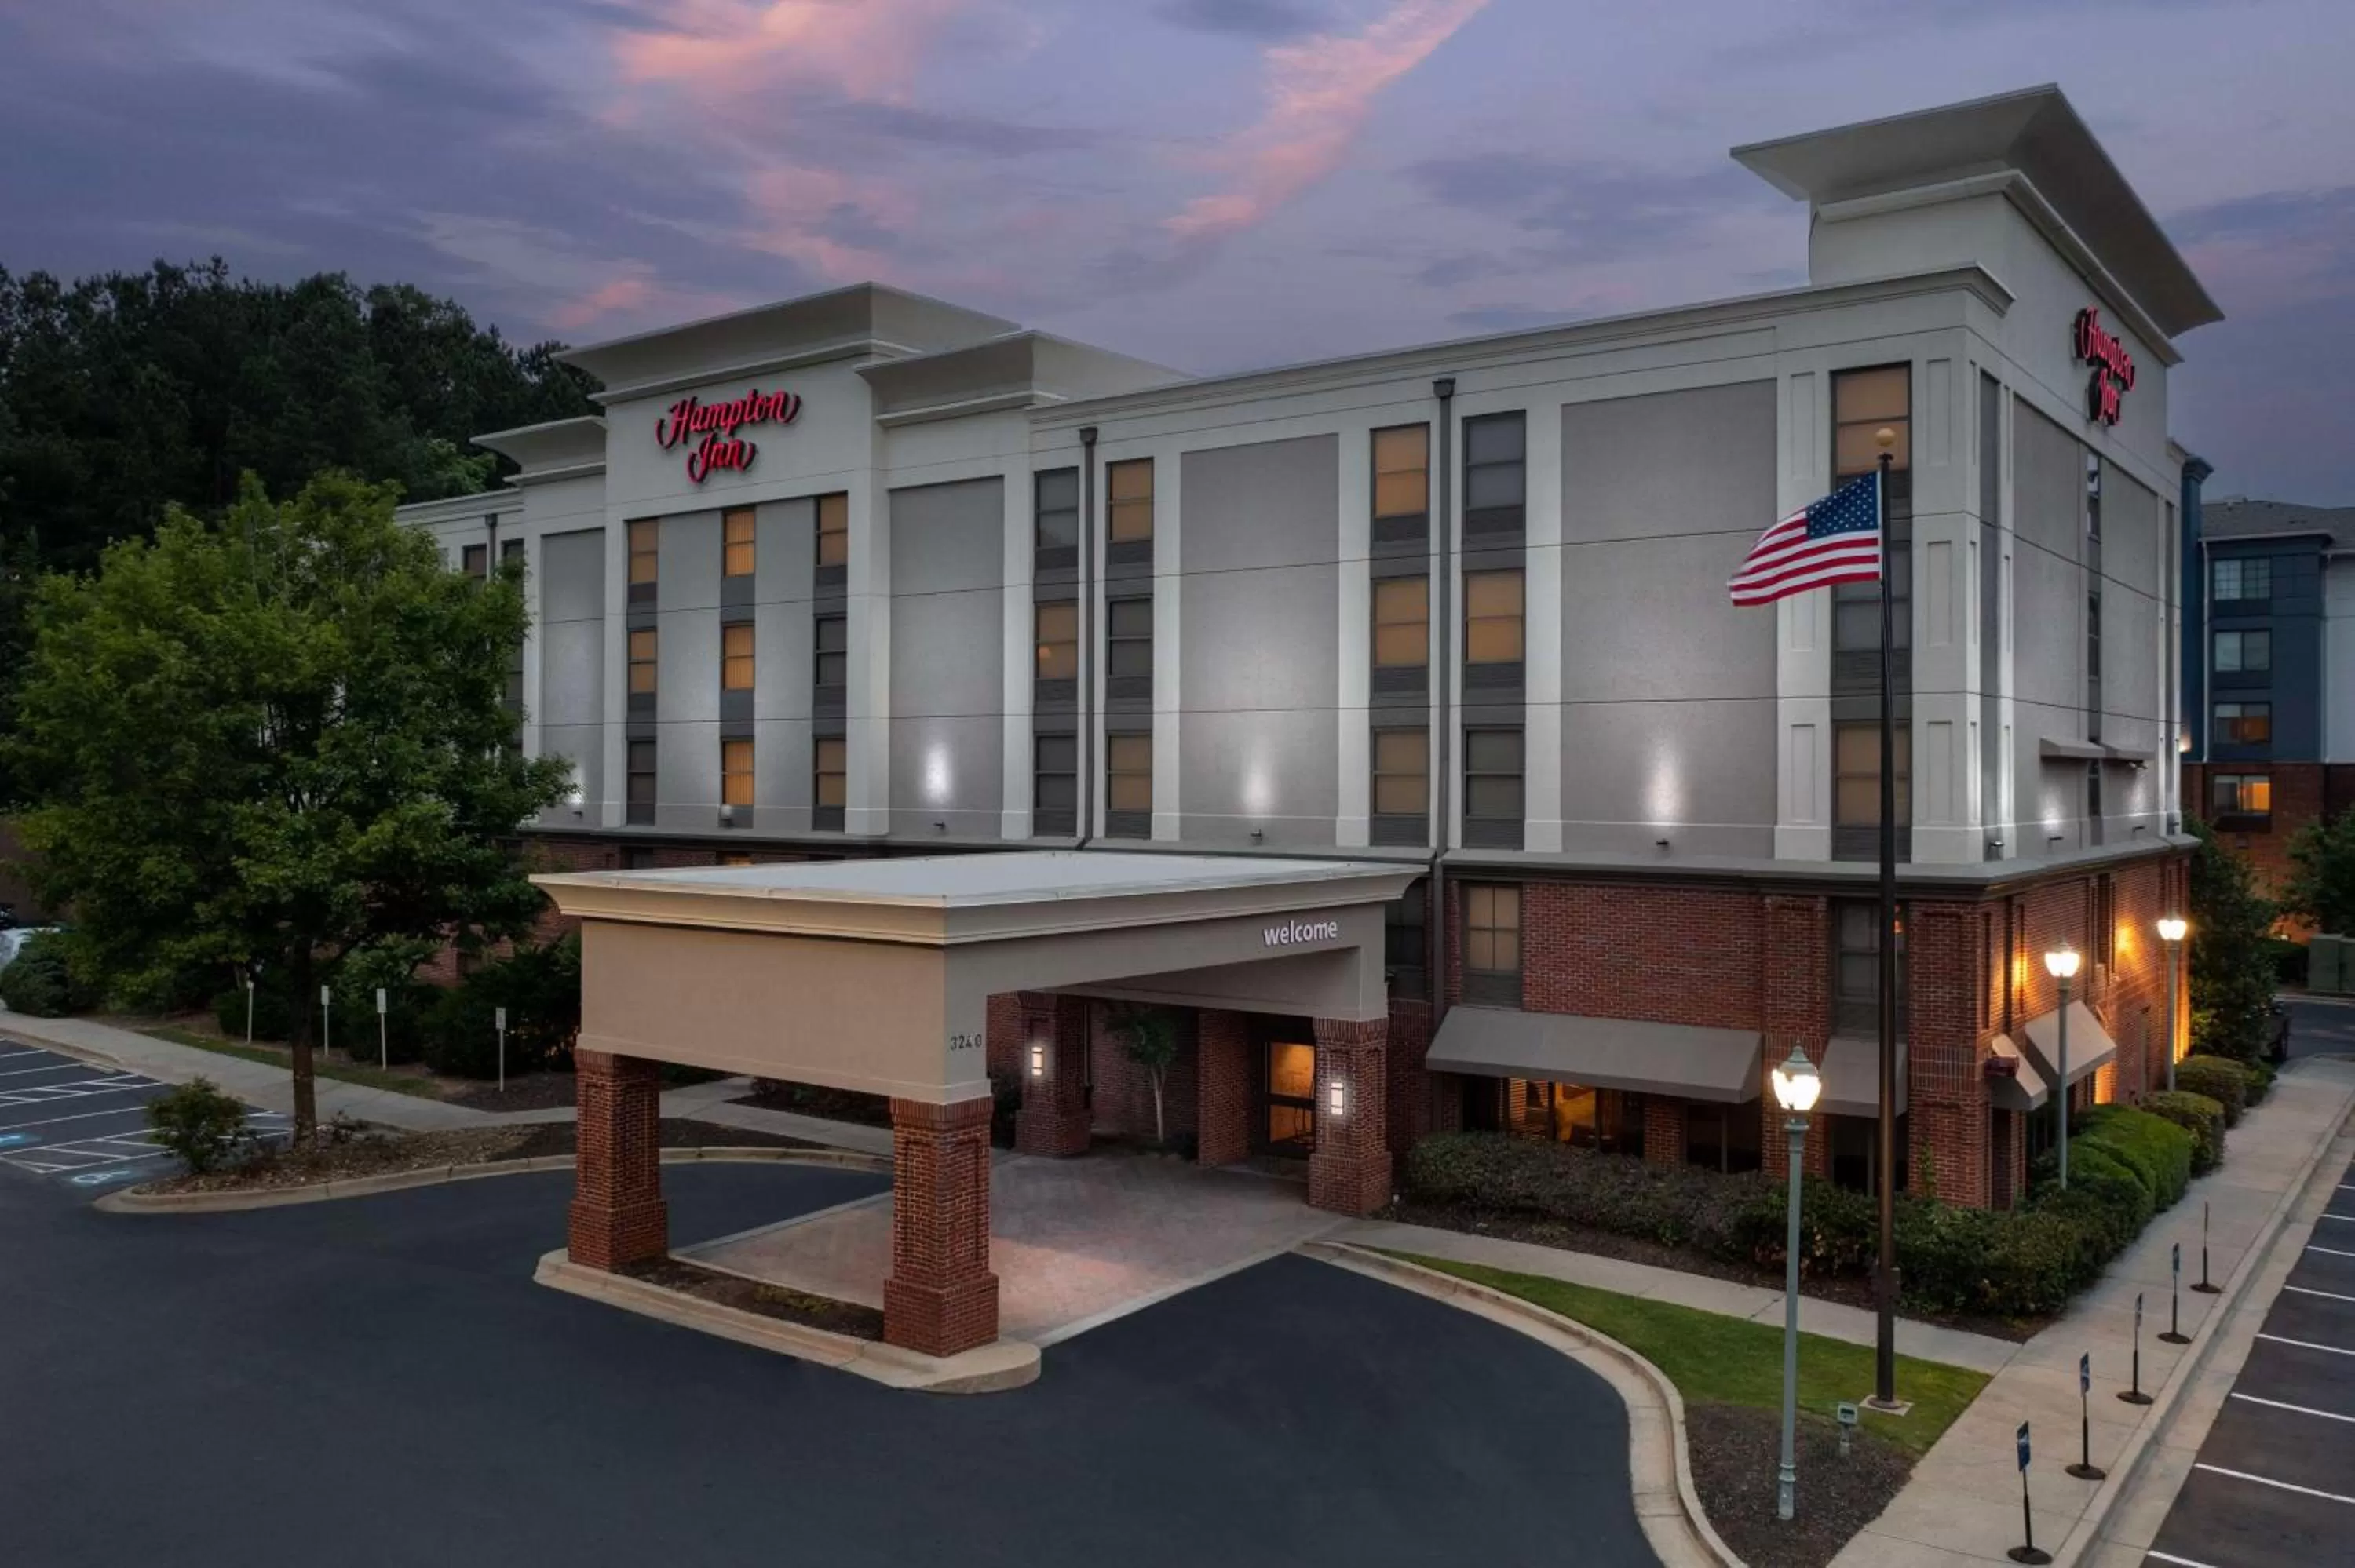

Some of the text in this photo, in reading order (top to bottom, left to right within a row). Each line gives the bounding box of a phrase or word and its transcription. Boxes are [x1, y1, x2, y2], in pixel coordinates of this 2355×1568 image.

[656, 389, 801, 449] Hampton
[688, 432, 757, 483] Inn
[1263, 920, 1338, 946] welcome
